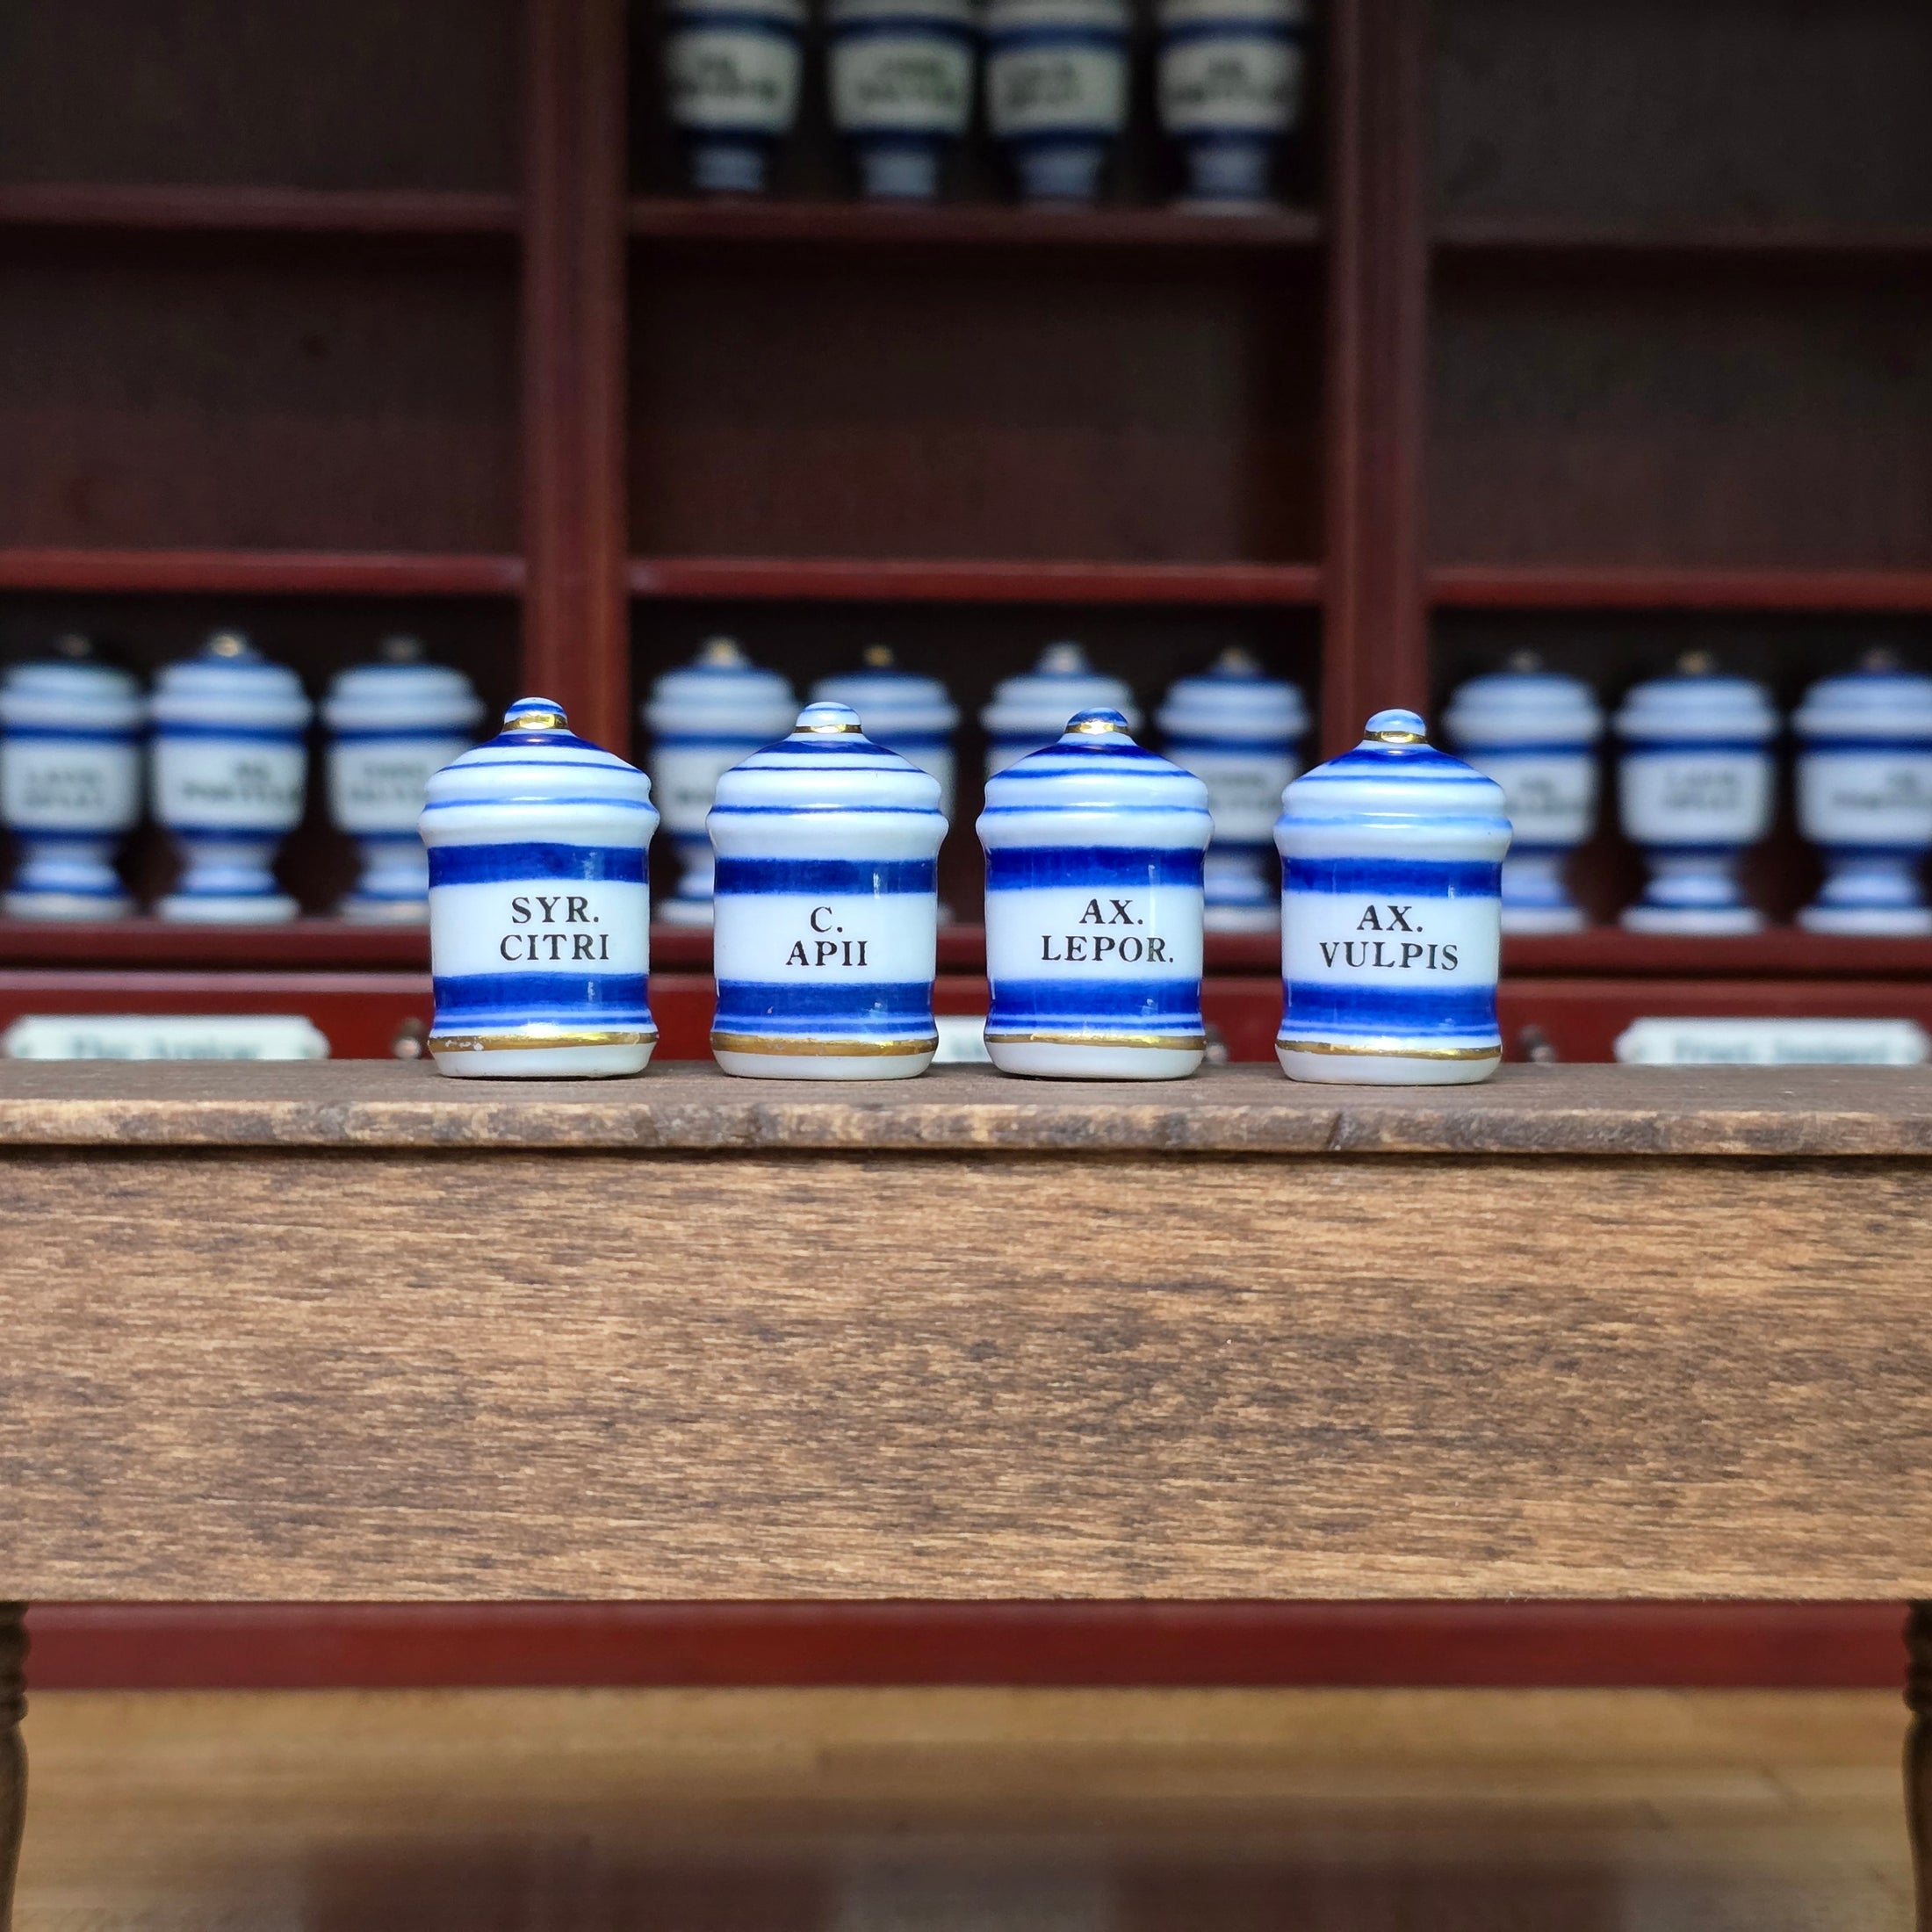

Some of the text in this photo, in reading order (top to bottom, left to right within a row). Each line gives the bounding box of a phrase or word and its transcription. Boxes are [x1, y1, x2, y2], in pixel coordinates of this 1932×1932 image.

[511, 896, 600, 925] SYR.
[810, 906, 843, 934] C.
[1078, 898, 1143, 926] AX.
[1356, 905, 1424, 933] AX.
[500, 934, 609, 962] CITRI
[785, 940, 868, 968] APII
[1041, 935, 1174, 964] LEPOR.
[1319, 941, 1459, 971] VULPIS
